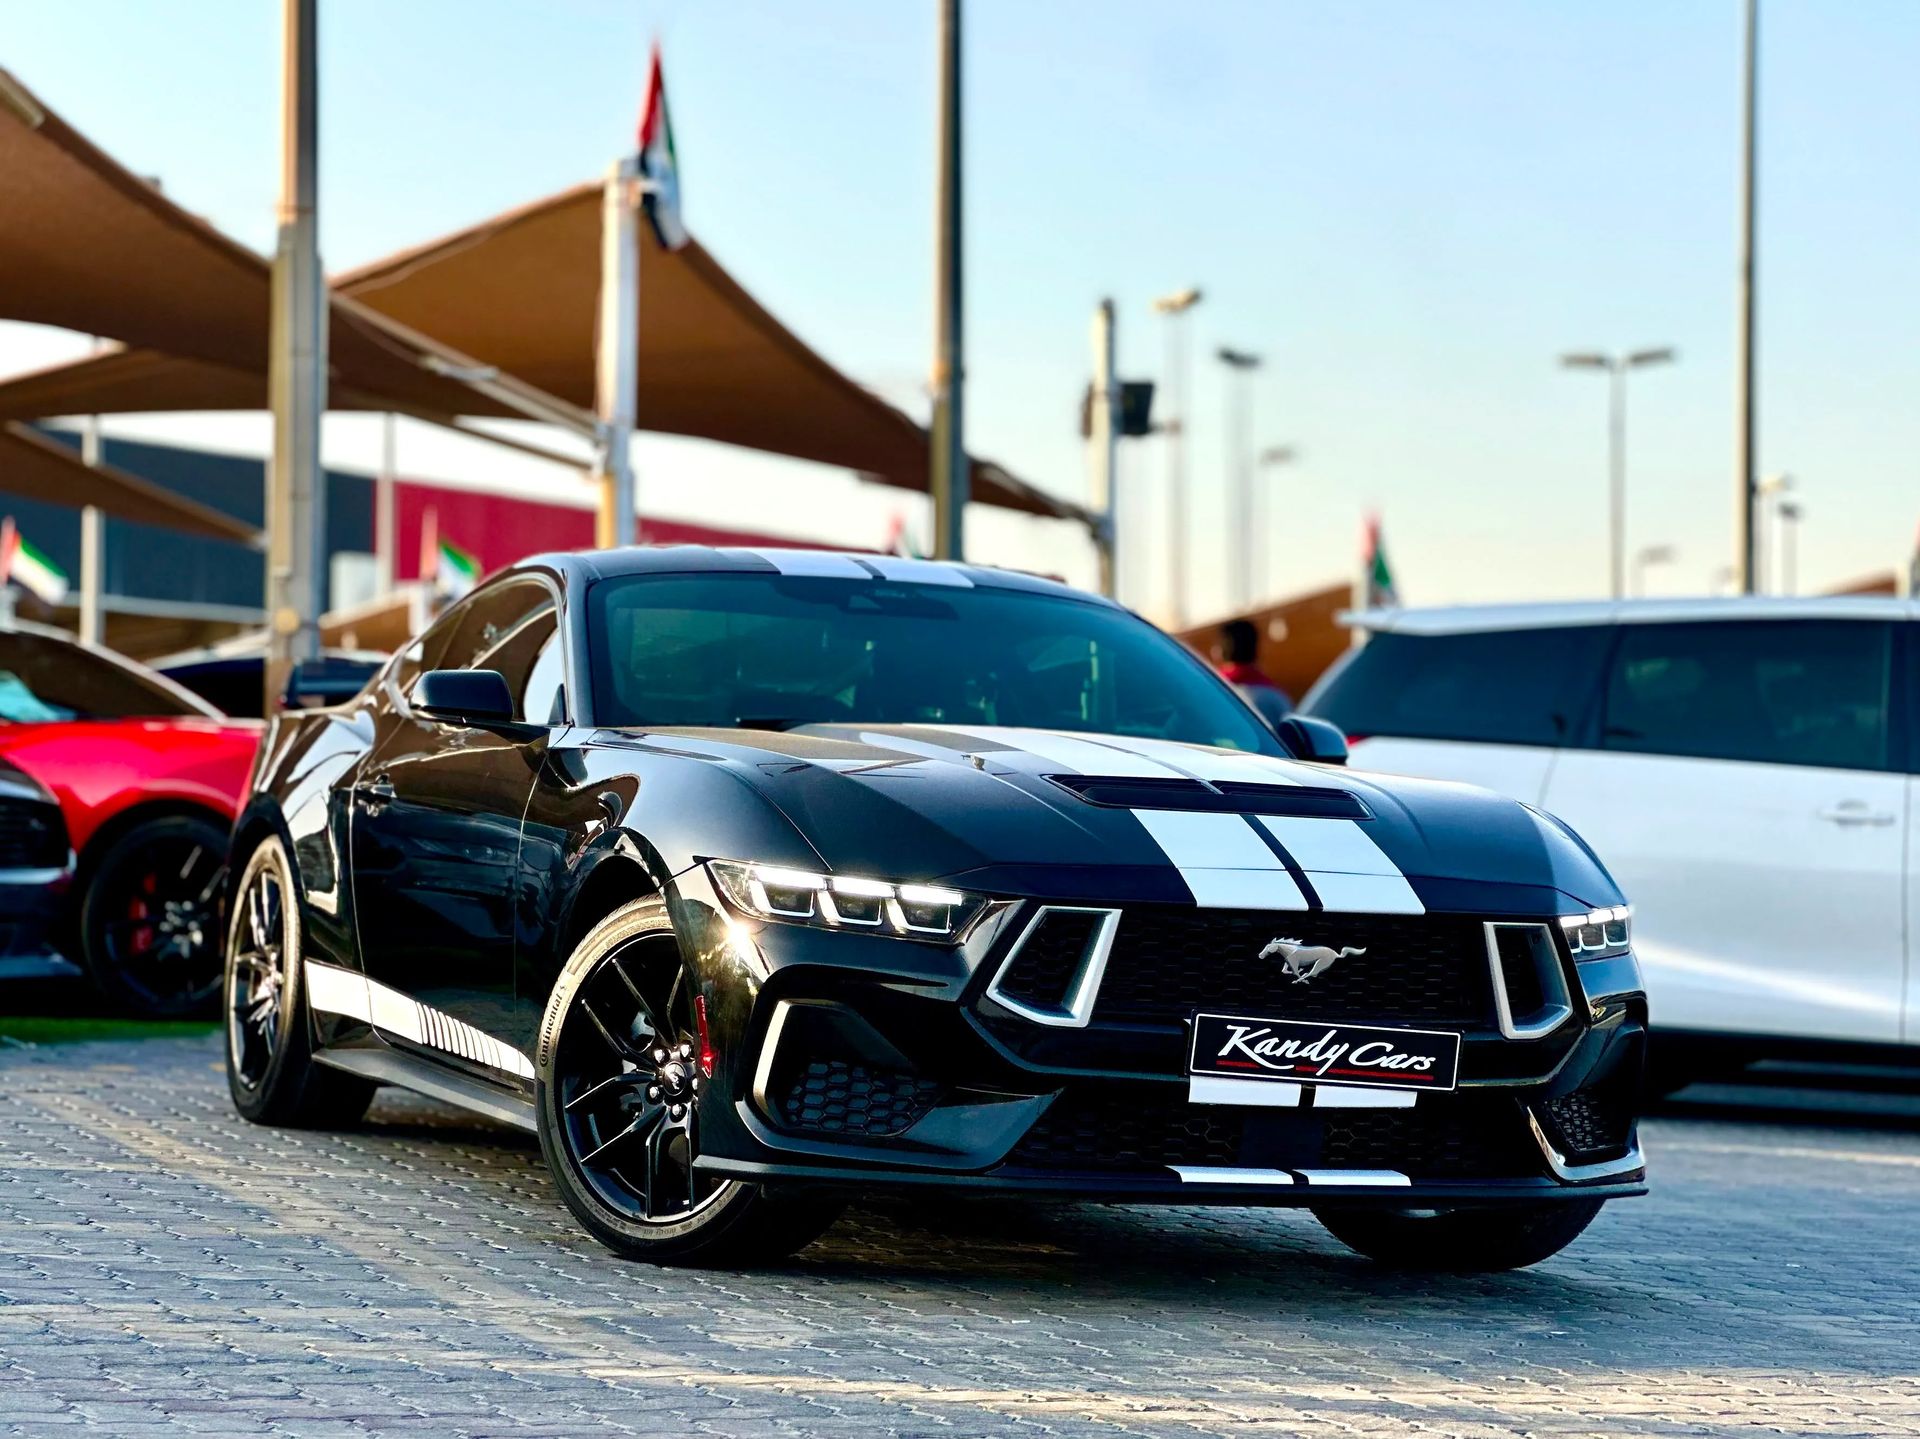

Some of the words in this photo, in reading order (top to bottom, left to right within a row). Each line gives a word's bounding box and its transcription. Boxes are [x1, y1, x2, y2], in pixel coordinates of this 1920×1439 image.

[540, 993, 562, 1067] Continental
[1217, 1024, 1349, 1076] Kandy
[1348, 1042, 1436, 1071] Cars
